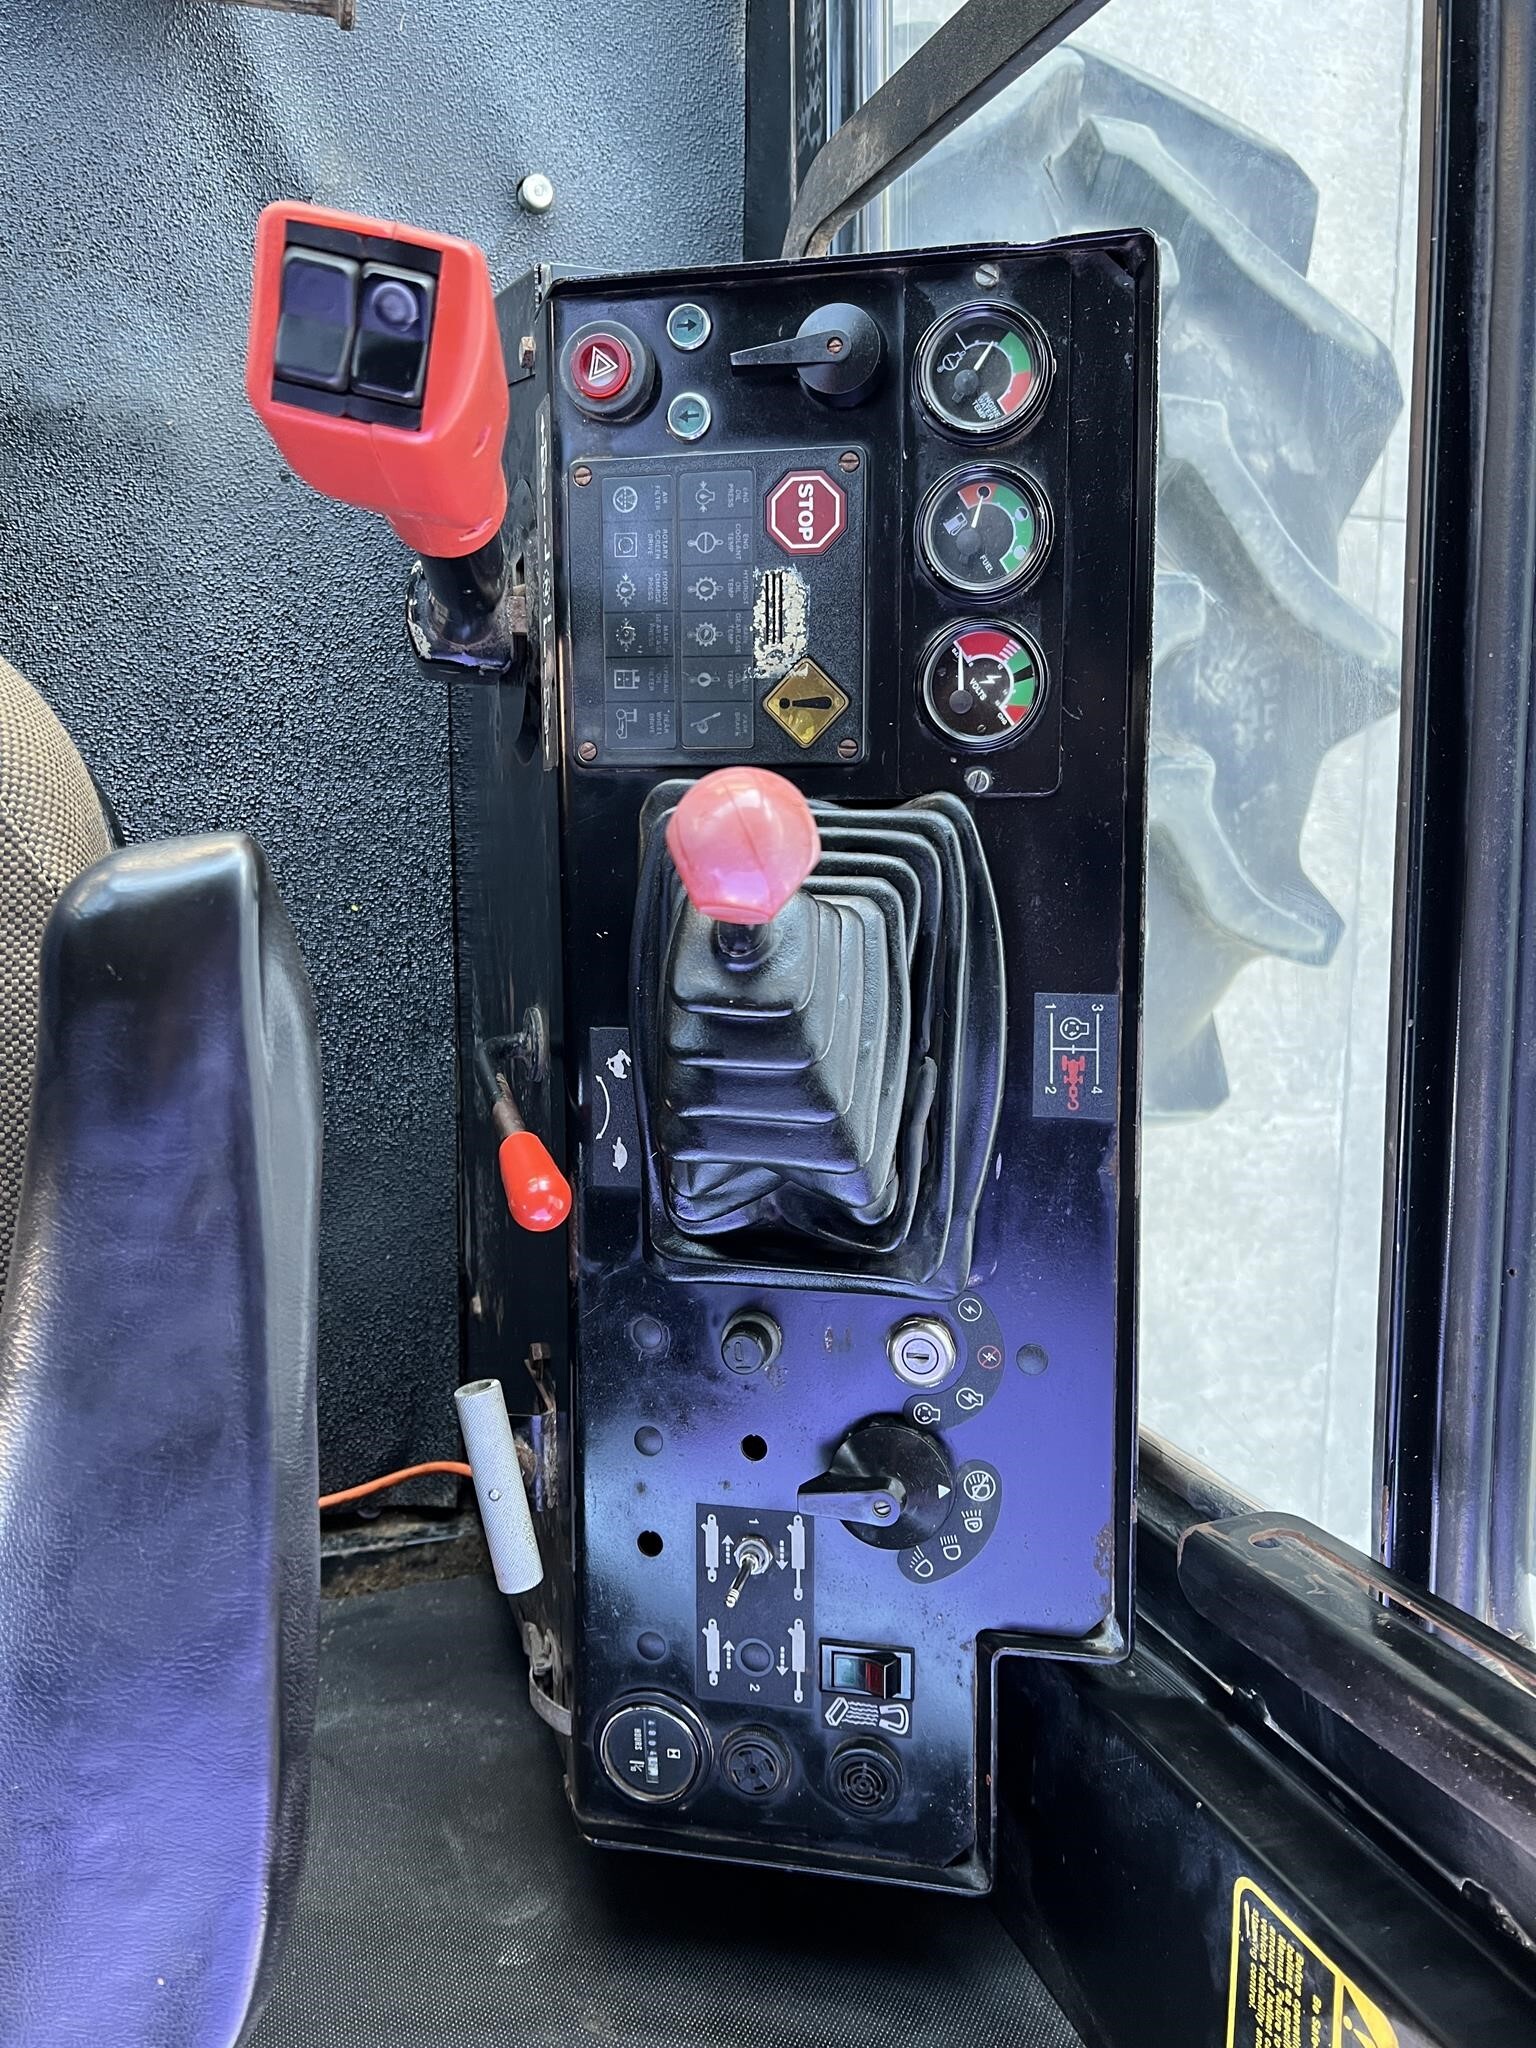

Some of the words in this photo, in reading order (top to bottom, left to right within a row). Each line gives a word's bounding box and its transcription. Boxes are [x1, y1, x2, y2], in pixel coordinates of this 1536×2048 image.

[972, 400, 985, 418] TEMP
[798, 483, 814, 541] STOP
[979, 554, 993, 574] FUEL
[969, 678, 987, 701] VOLTS
[1092, 1004, 1103, 1012] 3
[1045, 1086, 1056, 1094] 2
[1091, 1086, 1102, 1094] 4
[750, 1683, 759, 1692] 2
[634, 1728, 642, 1750] HOURS
[1259, 1918, 1269, 1962] vehicle
[1267, 1926, 1276, 1975] amount
[1277, 1935, 1286, 1983] Manual.
[1286, 1944, 1295, 1989] ballast
[1267, 1977, 1275, 1993] of
[1294, 1952, 1304, 1996] Before
[1248, 1963, 1257, 2009] control.
[1255, 1965, 1267, 2026] instability
[1285, 1989, 1292, 2005] as
[1264, 1993, 1274, 2037] ballast
[1274, 1988, 1284, 2031] Failure
[1312, 1995, 1321, 2014] Be
[1274, 2034, 1282, 2048] to
